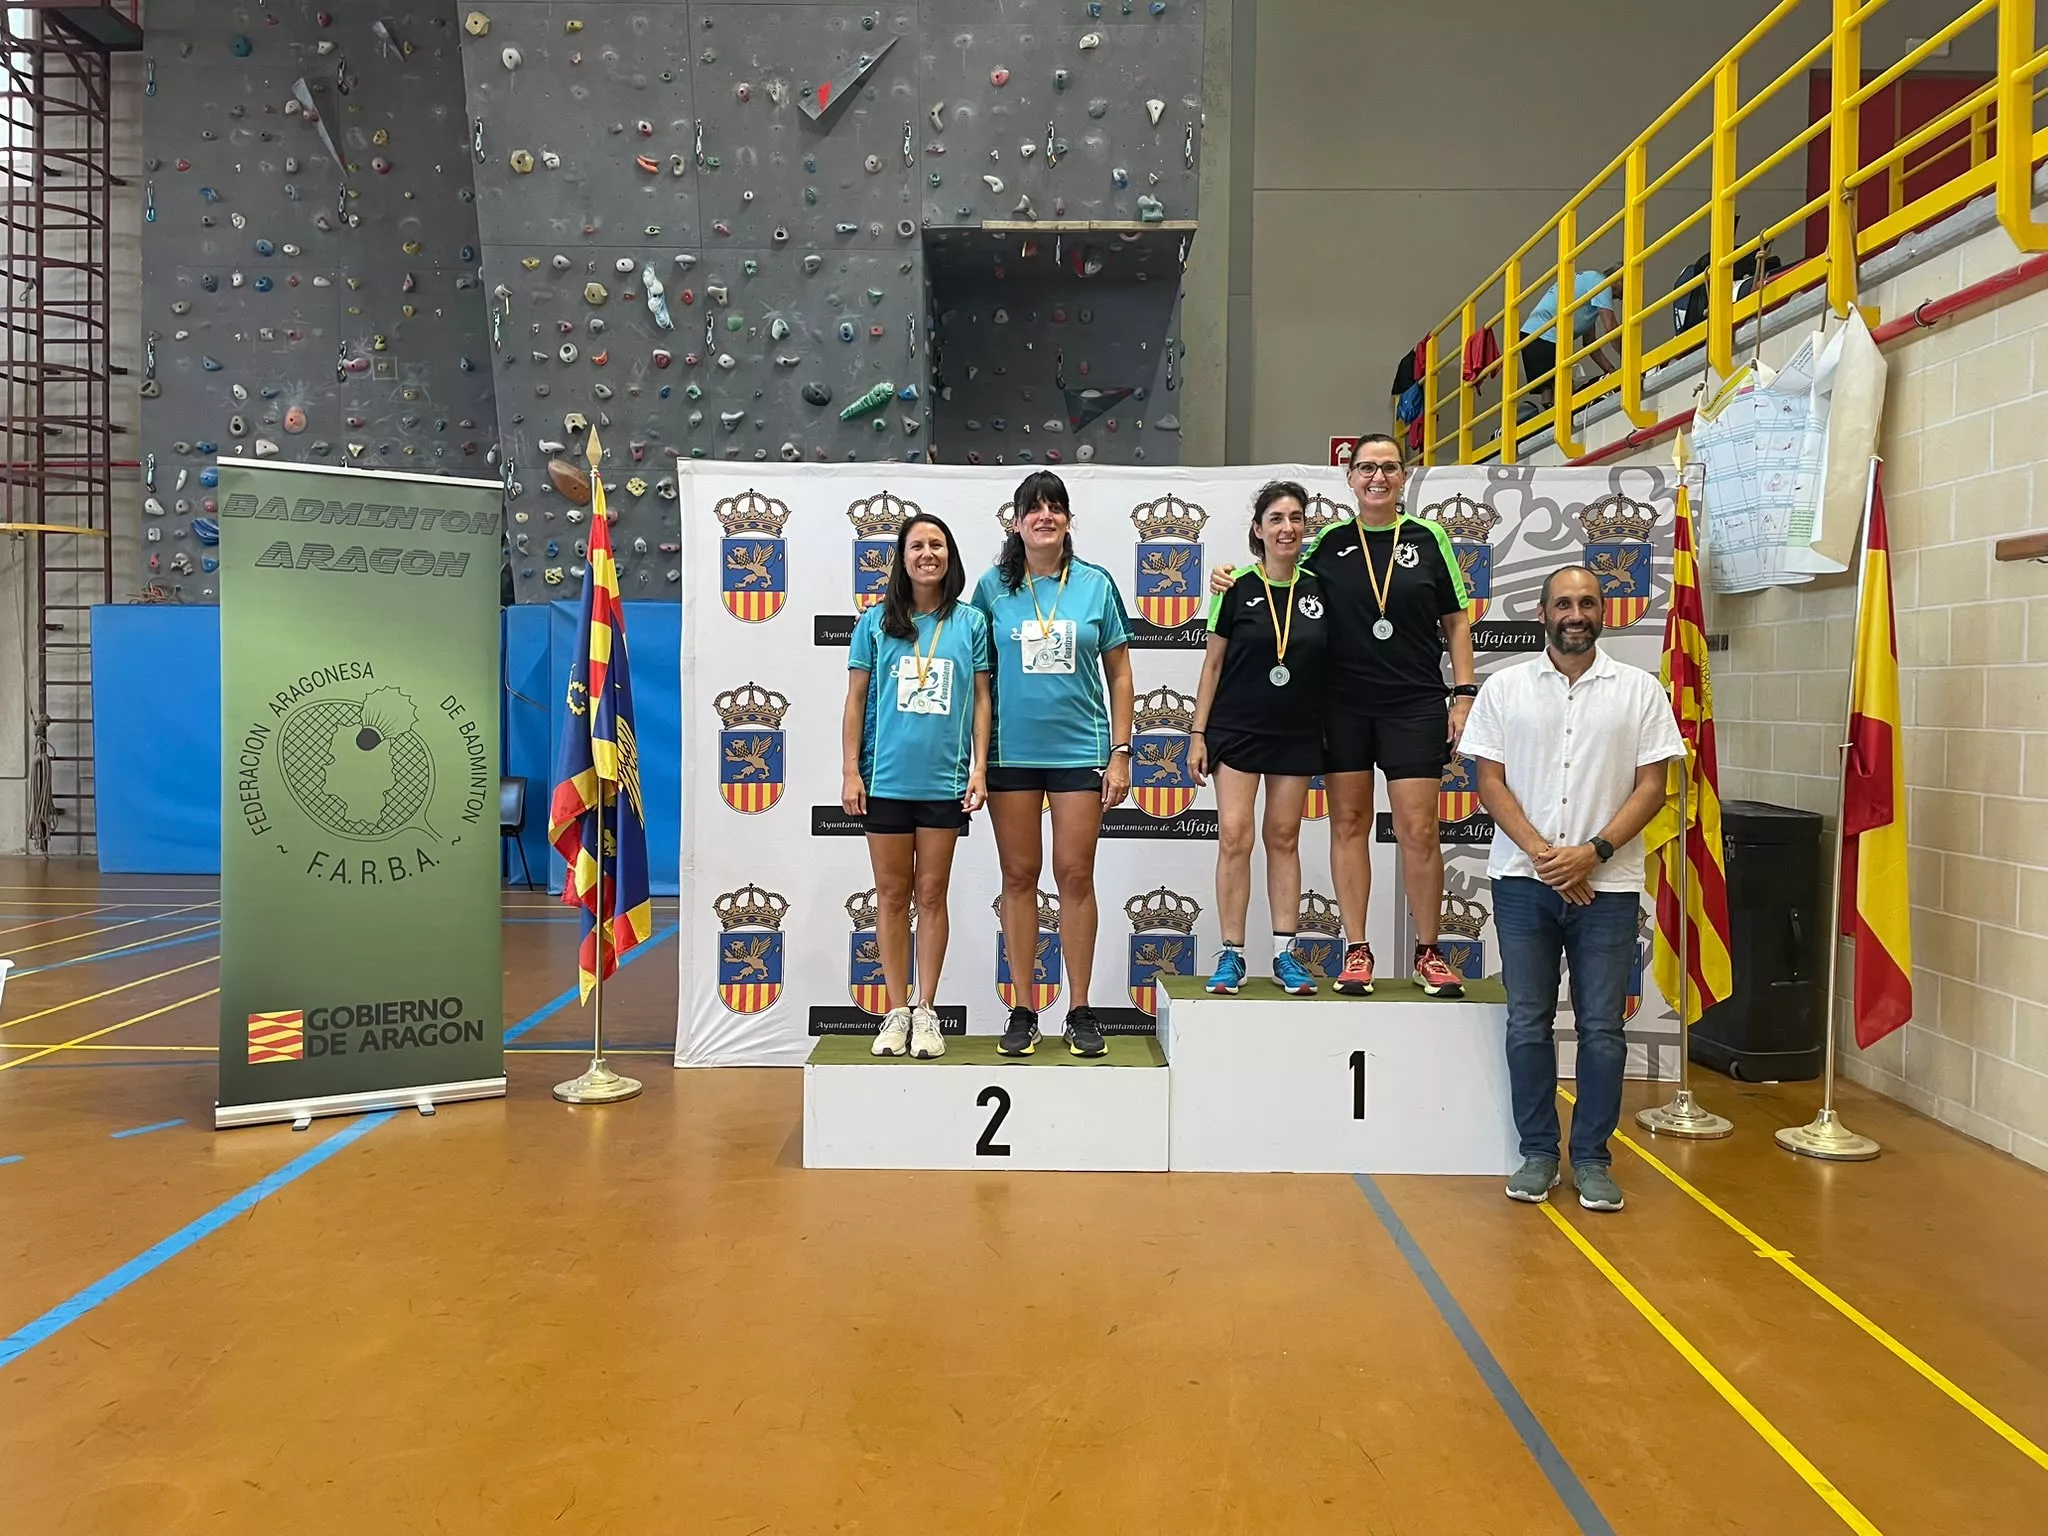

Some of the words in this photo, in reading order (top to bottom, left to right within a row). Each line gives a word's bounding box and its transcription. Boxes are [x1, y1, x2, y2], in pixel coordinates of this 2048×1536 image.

[222, 493, 499, 535] BADMINTON
[255, 541, 470, 577] ARAGON
[821, 631, 854, 640] Ayunta
[239, 723, 271, 835] FEDERACION
[268, 662, 374, 718] ARAGONESA
[440, 695, 466, 720] DE
[458, 721, 488, 824] BADMINTON
[1172, 819, 1218, 836] Alfaja
[306, 847, 440, 885] F.A.R.B.A.
[307, 996, 463, 1031] GOBIERNO
[816, 1021, 876, 1030] Ayuntamiento
[307, 1032, 347, 1058] DE
[358, 1020, 484, 1053] ARAGON
[1349, 1050, 1366, 1120] 1
[976, 1085, 1011, 1156] 2
